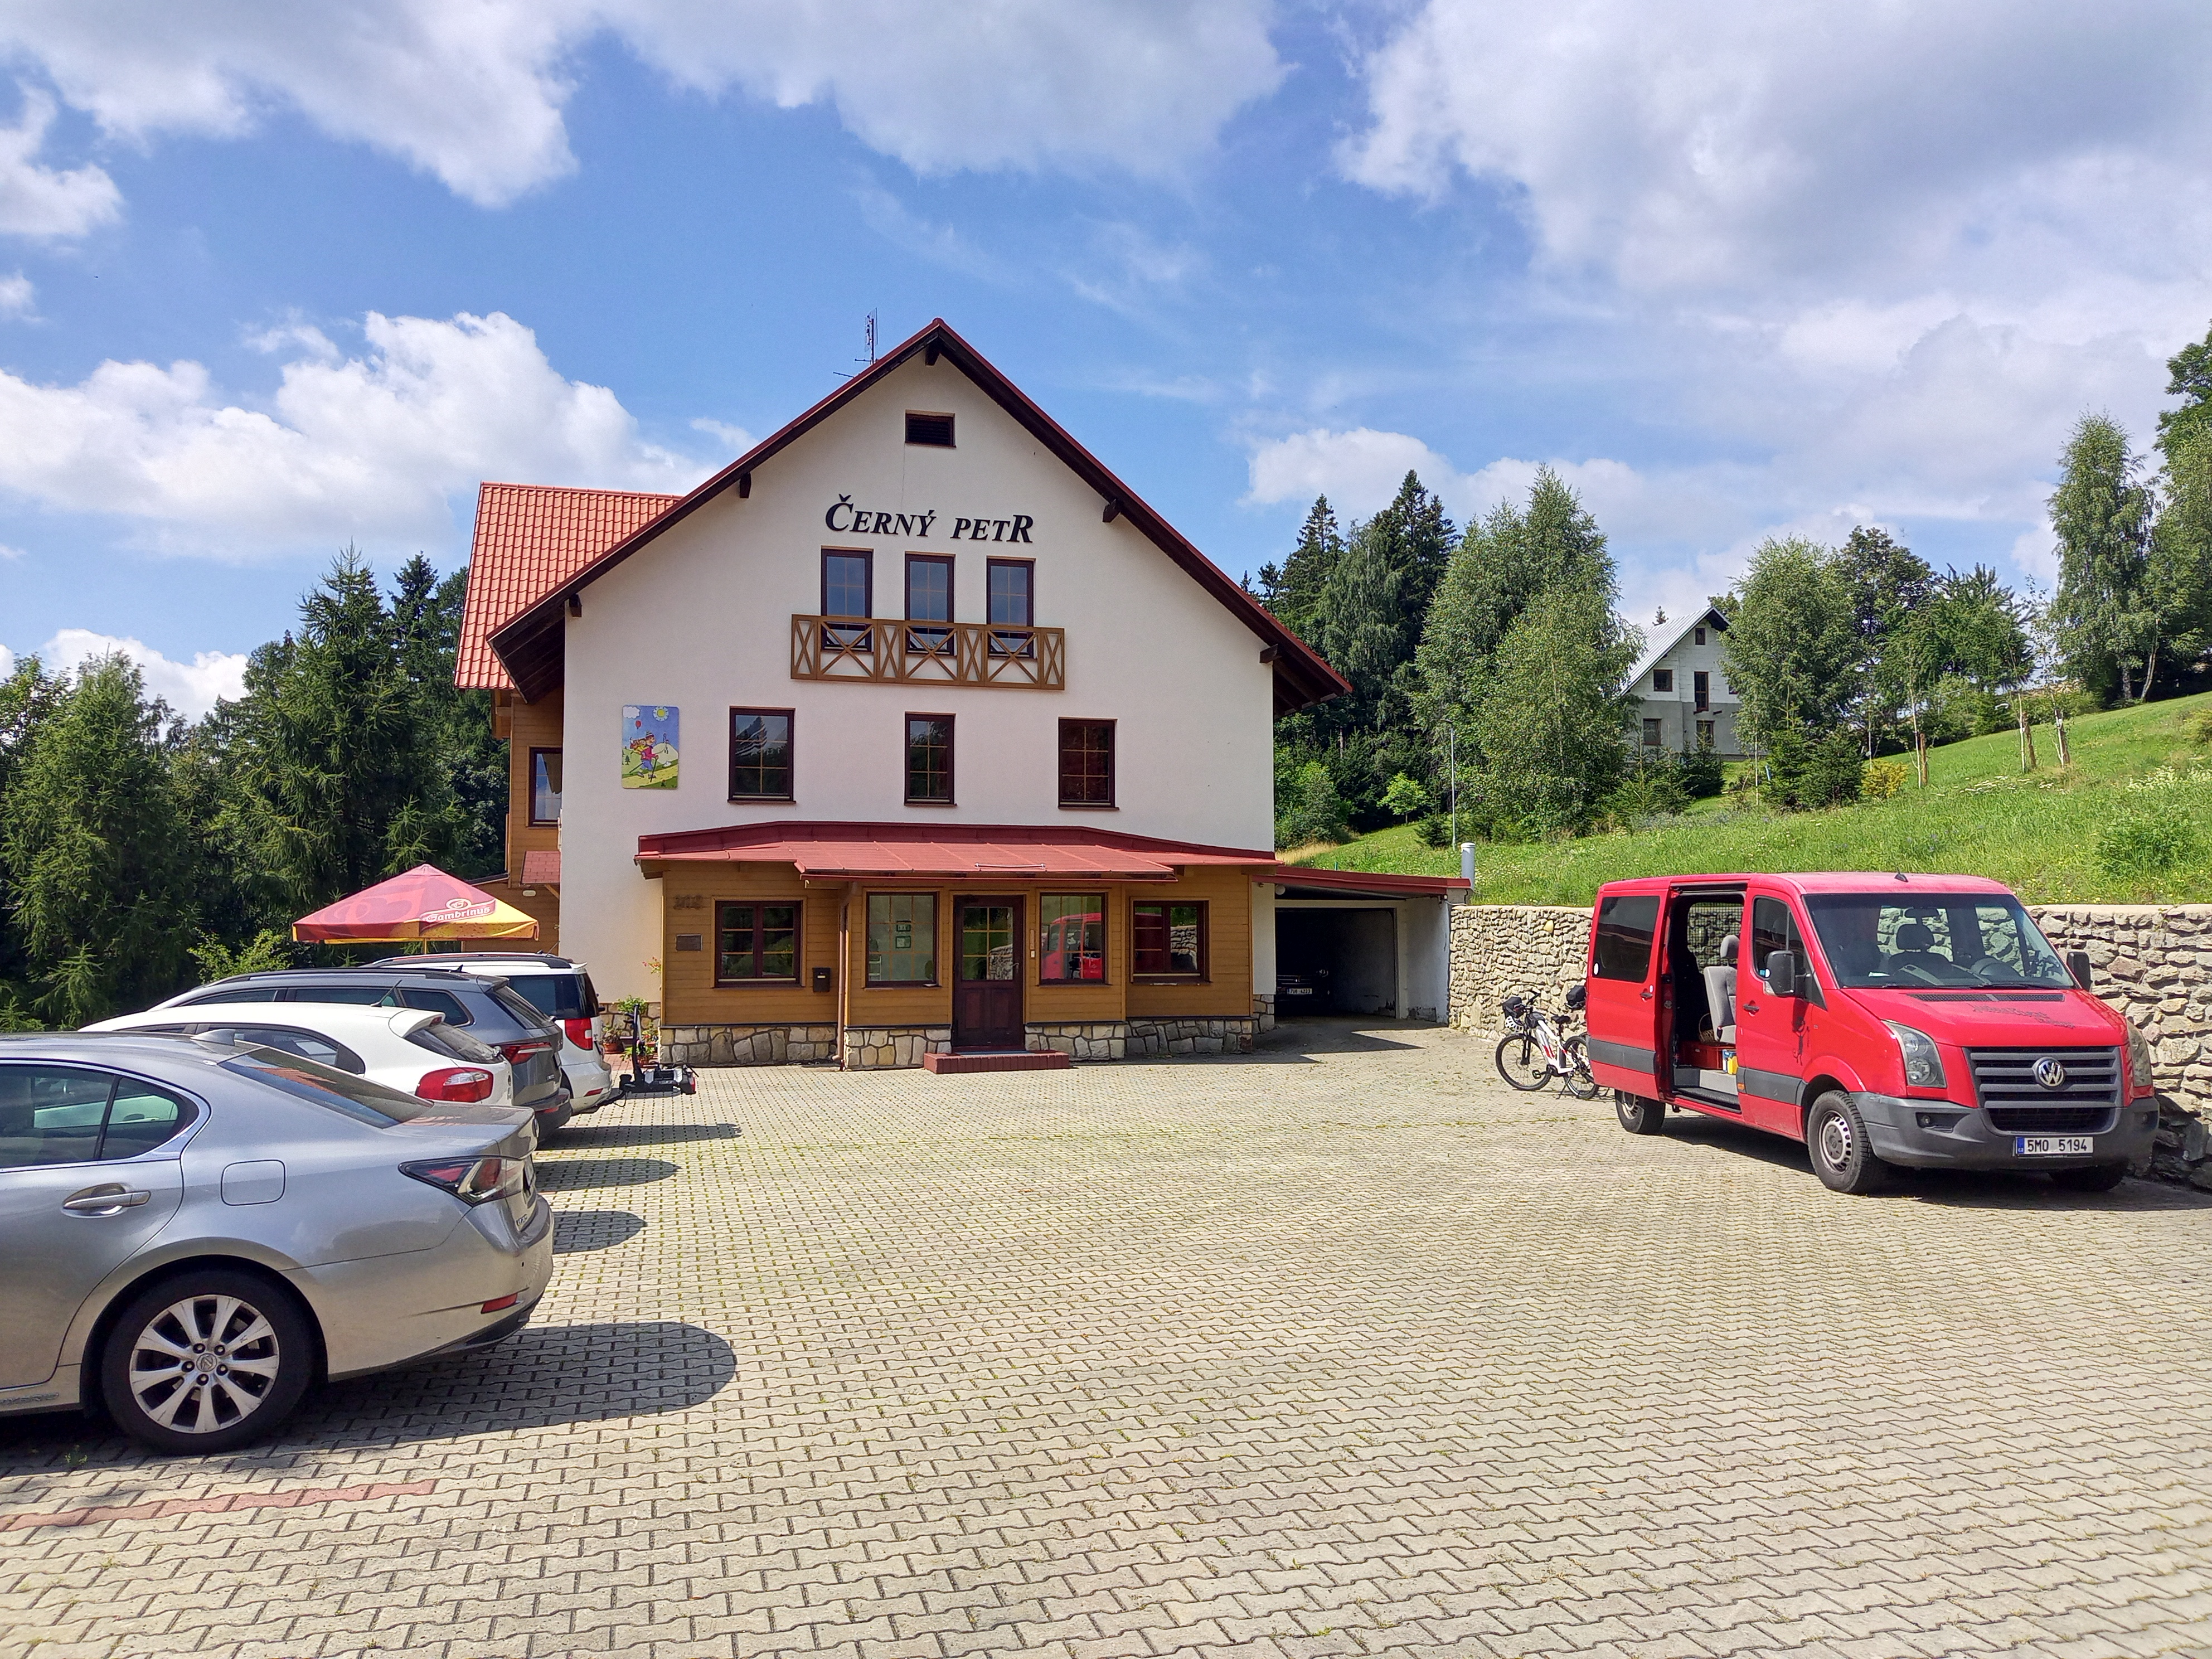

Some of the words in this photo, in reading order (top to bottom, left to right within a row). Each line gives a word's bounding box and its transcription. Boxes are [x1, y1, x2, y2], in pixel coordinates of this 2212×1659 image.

[825, 493, 937, 537] ČERNÝ
[422, 906, 491, 923] Gambrinus
[2058, 1138, 2088, 1152] 5194
